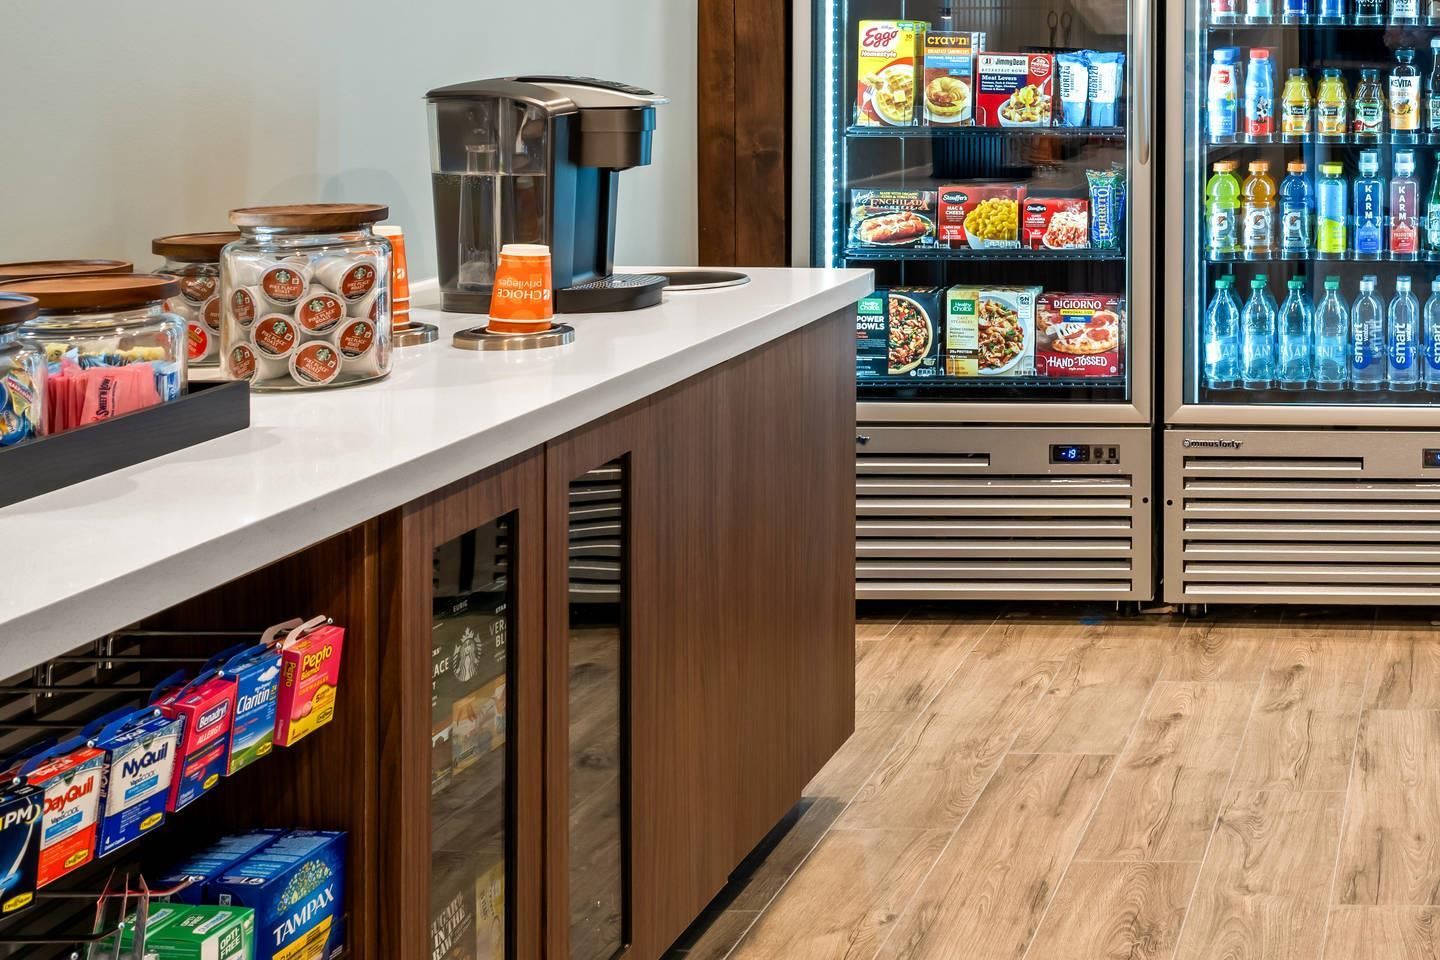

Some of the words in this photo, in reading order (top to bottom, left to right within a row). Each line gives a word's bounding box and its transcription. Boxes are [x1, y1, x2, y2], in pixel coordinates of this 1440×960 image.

[863, 27, 899, 48] Eggo
[870, 198, 931, 211] ENCHILADA
[942, 194, 968, 203] Stouffer's
[1098, 188, 1110, 237] BURRITO
[1364, 184, 1373, 228] KARMA
[1398, 185, 1406, 228] KARMA
[497, 289, 541, 301] CHOICE
[856, 315, 885, 323] POWER
[1353, 322, 1363, 364] smart
[1395, 322, 1406, 365] smart
[302, 645, 333, 672] Pepto
[199, 703, 228, 726] Benadryl
[236, 687, 271, 715] Claritin
[122, 742, 169, 779] NyQuil
[44, 775, 95, 814] DayQuil
[273, 883, 334, 946] TAMPAX
